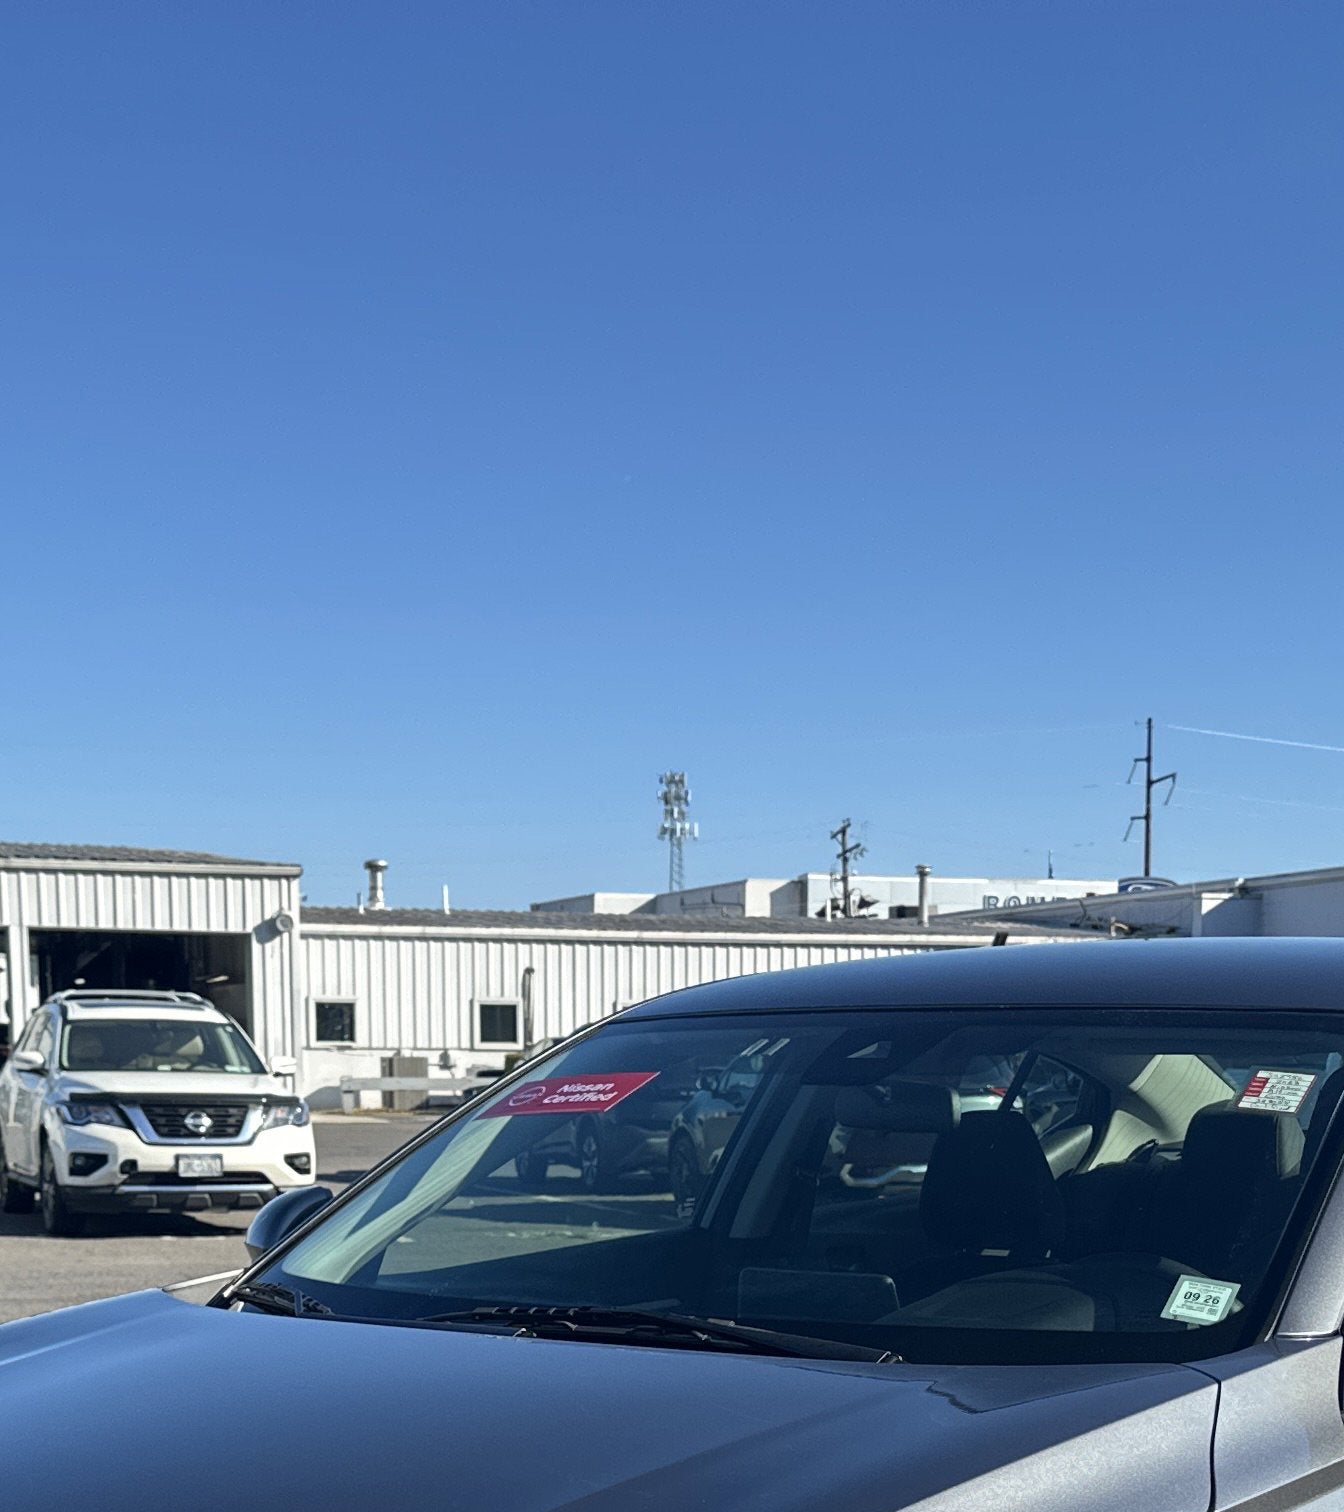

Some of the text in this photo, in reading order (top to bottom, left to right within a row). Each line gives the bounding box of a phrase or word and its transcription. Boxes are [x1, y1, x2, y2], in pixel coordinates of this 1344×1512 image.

[557, 1083, 615, 1093] Nissan
[542, 1091, 619, 1105] Certified
[1183, 1291, 1221, 1305] 09 26
